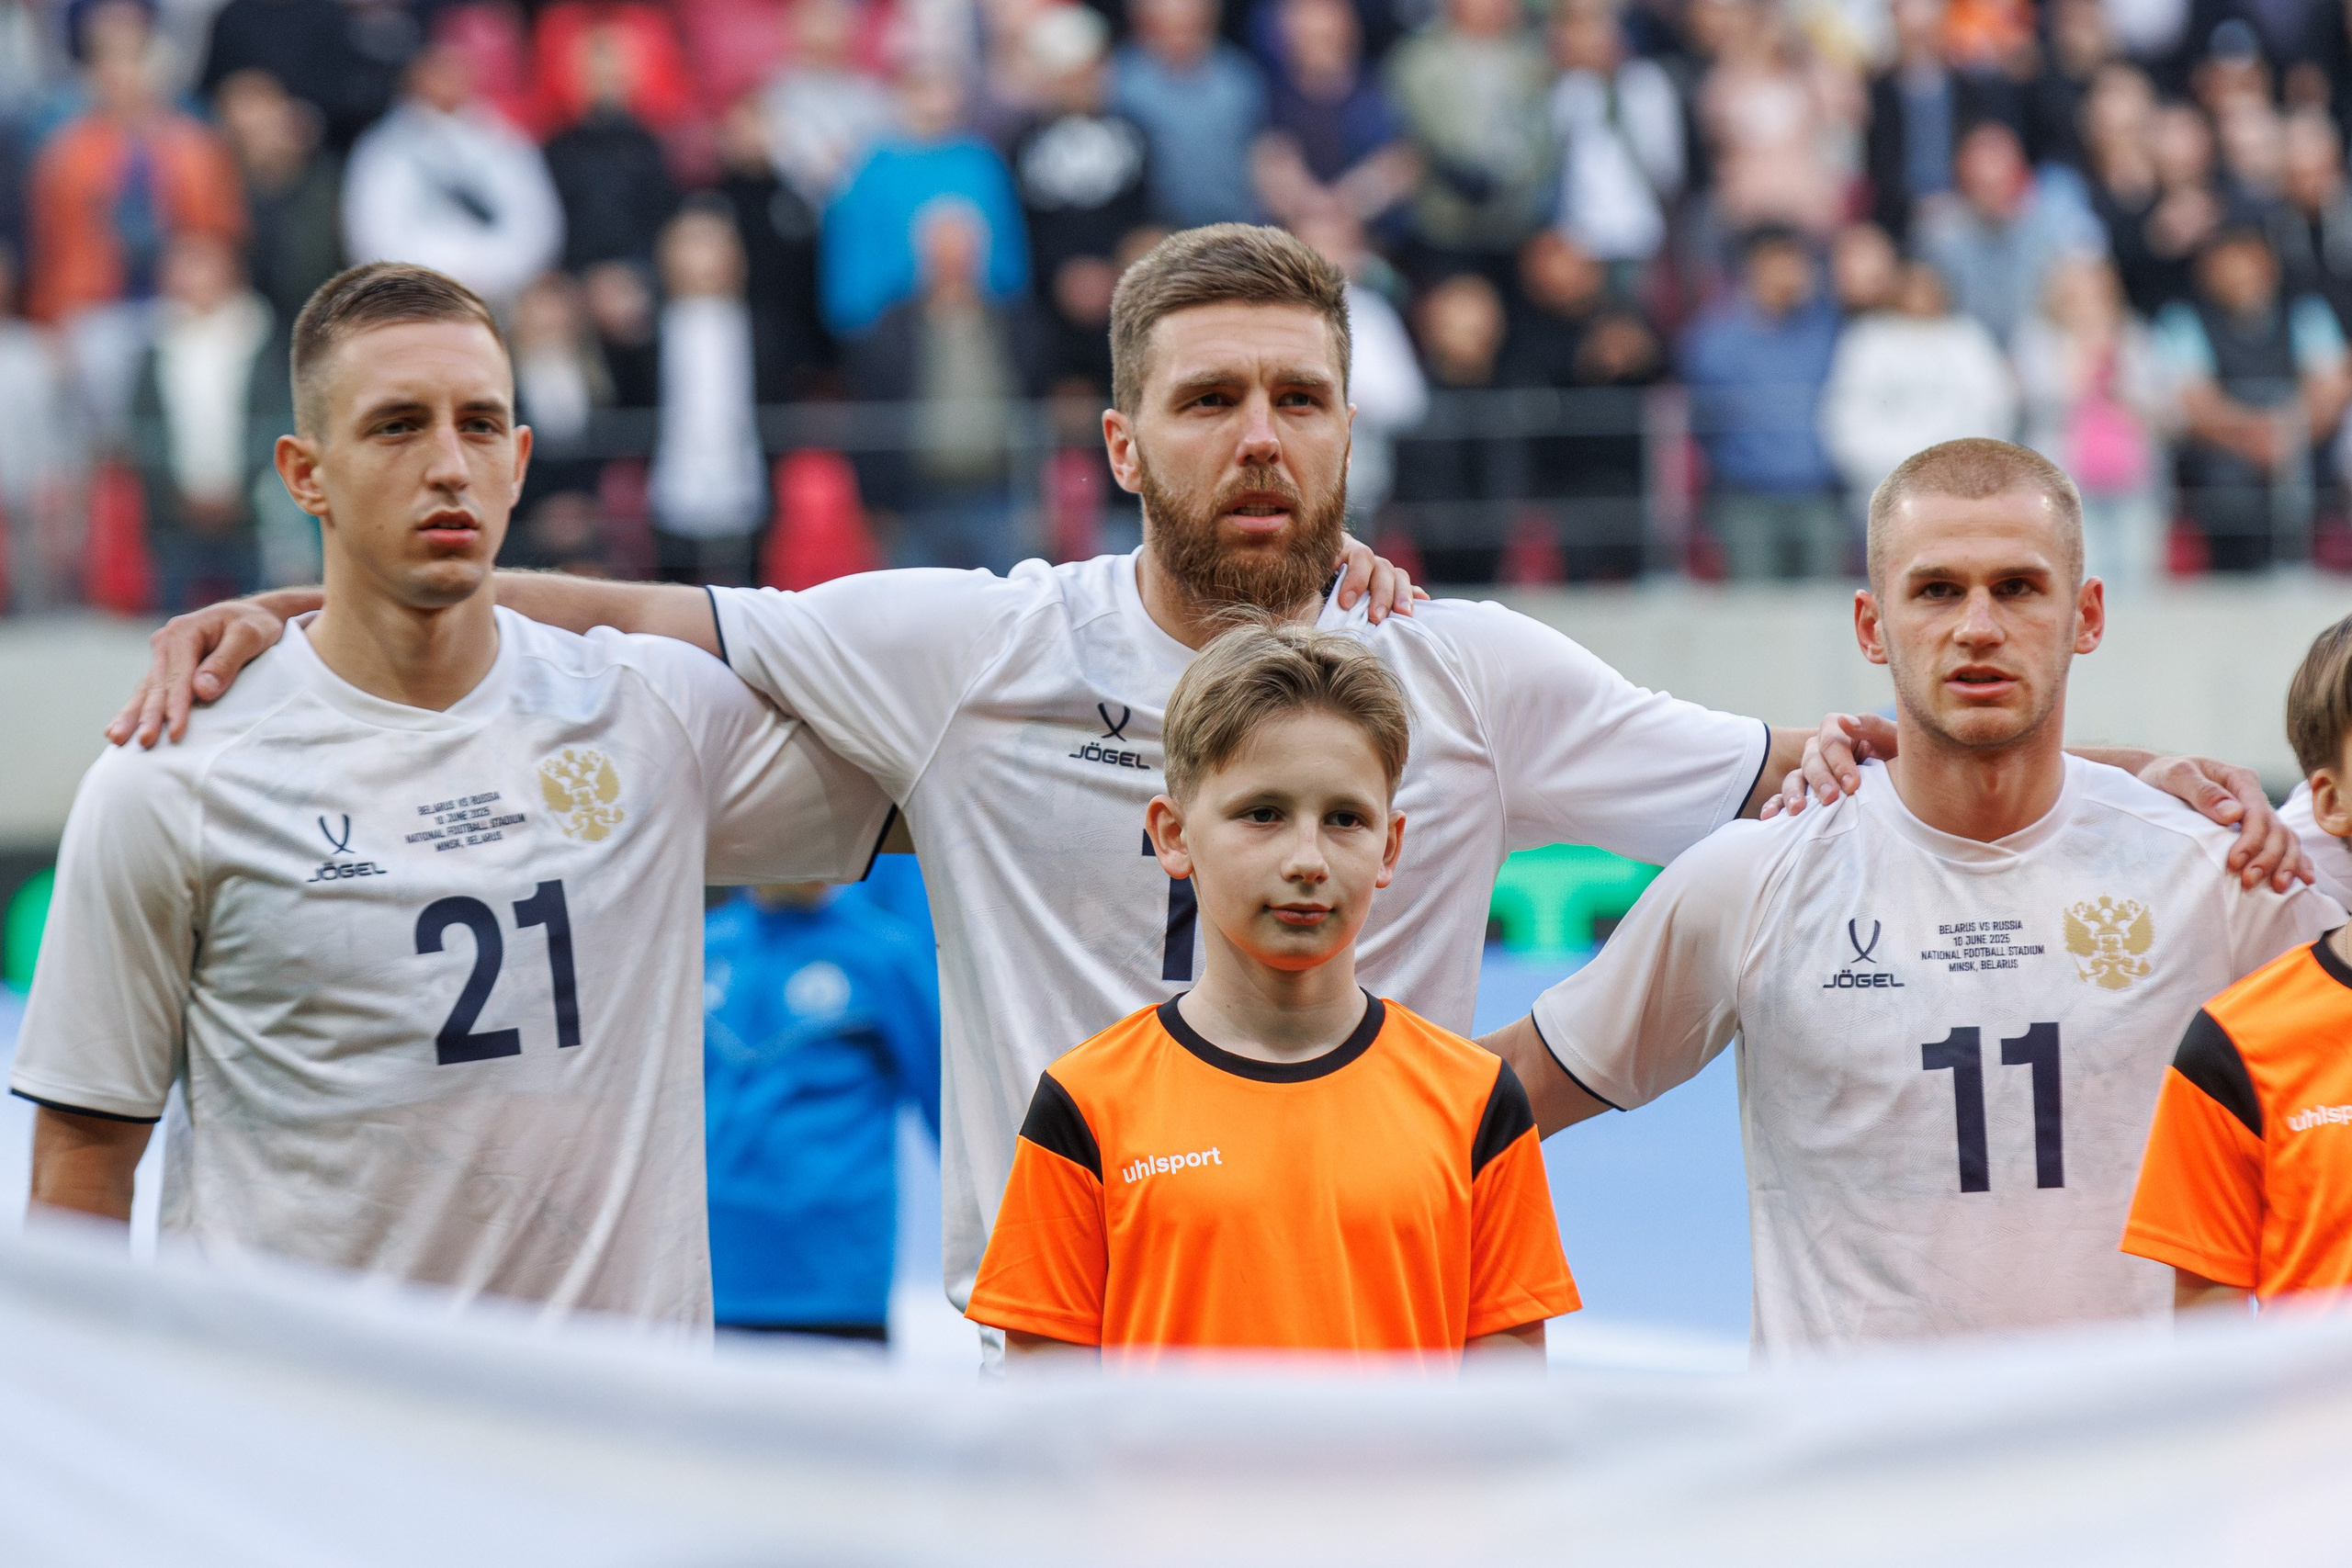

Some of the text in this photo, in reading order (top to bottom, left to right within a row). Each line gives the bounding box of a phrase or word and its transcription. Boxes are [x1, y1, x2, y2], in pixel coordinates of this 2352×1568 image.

[1069, 741, 1150, 770] JÖGEL
[404, 829, 446, 843] NATIONAL
[307, 861, 388, 883] JÖGEL
[1939, 920, 2023, 934] BELARUS VS RUSSIA
[1953, 933, 2010, 946] 10 JUNE 2025
[1921, 944, 2045, 960] NATIONAL FOOTBALL STADIUM
[414, 879, 582, 1066] 21
[1949, 959, 2018, 973] MINSK, BELARUS
[1823, 969, 1905, 989] JÖGEL
[1921, 1021, 2065, 1192] 11
[1122, 1146, 1223, 1184] uhlsport
